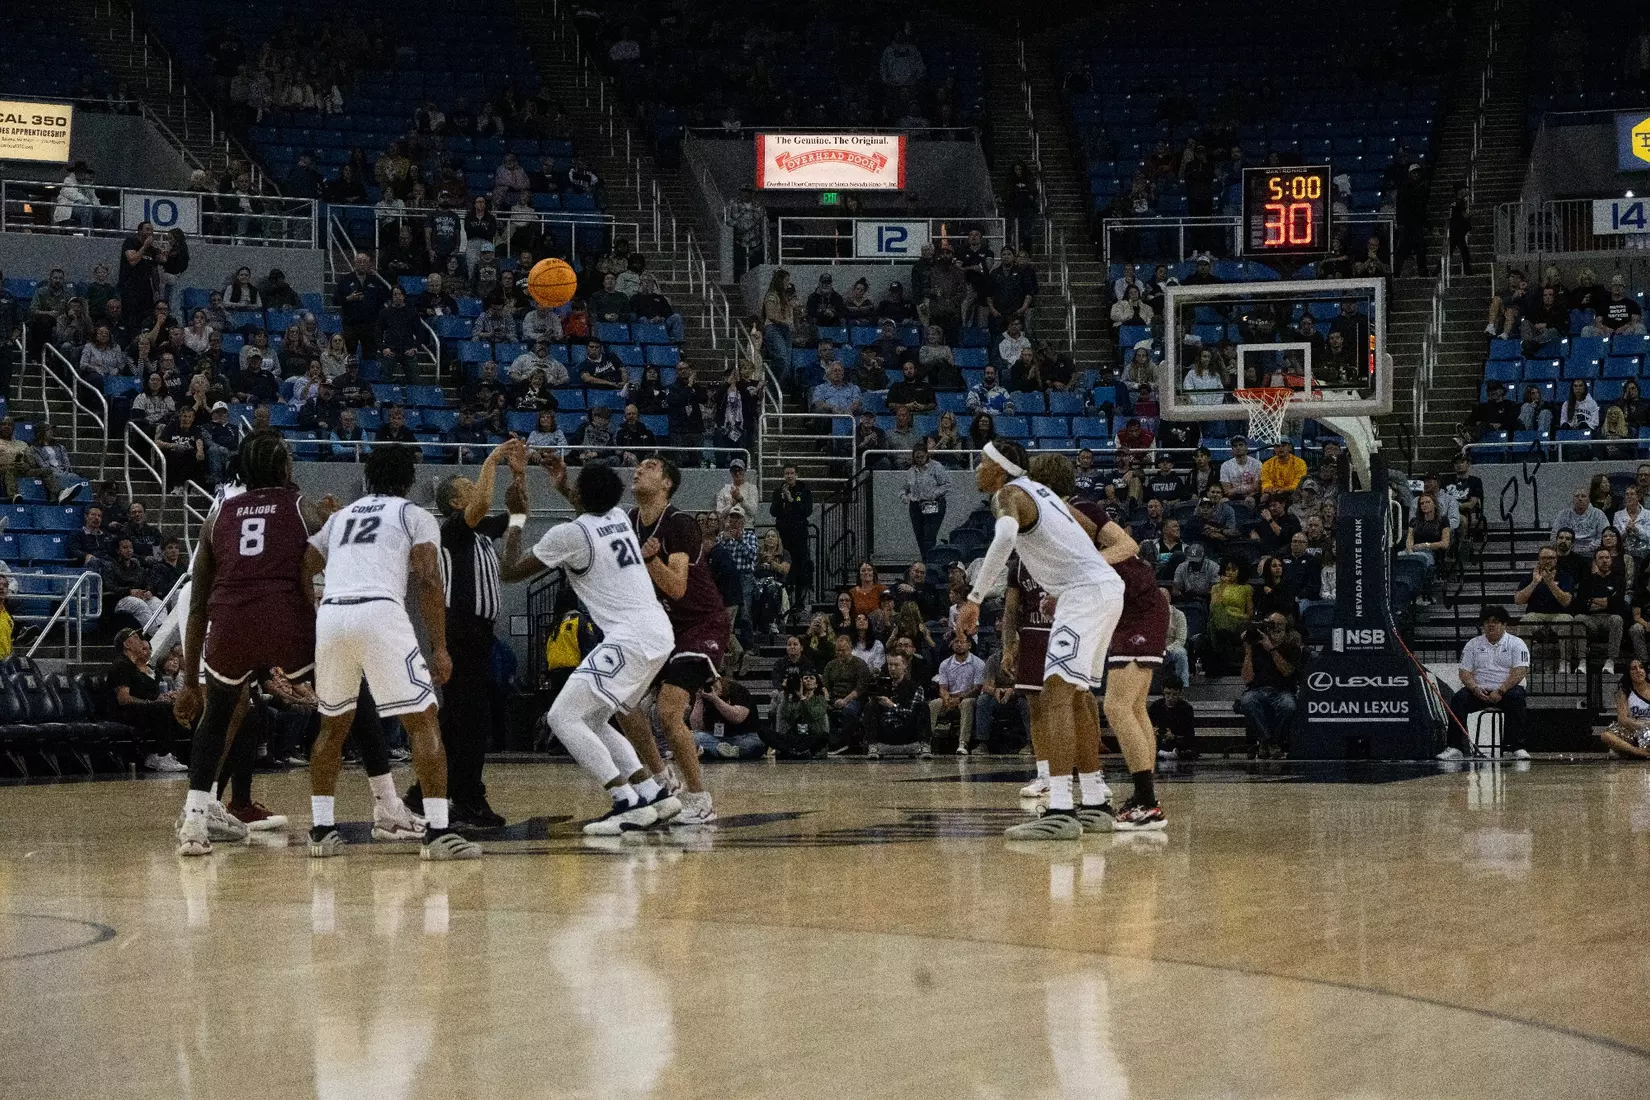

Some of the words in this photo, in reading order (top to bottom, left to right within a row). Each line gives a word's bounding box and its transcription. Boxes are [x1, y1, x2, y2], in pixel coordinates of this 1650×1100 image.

[0, 127, 10, 135] ES
[11, 128, 67, 138] APPRENTICESHIP
[32, 115, 67, 127] 350
[775, 136, 791, 145] The
[794, 136, 831, 145] Genuine.
[833, 136, 849, 145] The
[851, 136, 889, 146] Original.
[787, 151, 845, 169] OVERHEAD
[847, 153, 875, 169] DOOR
[1269, 176, 1321, 200] 5:00
[143, 198, 179, 227] 10
[1264, 203, 1312, 245] 30
[1612, 202, 1648, 230] 14
[877, 226, 908, 252] 12
[239, 517, 266, 557] 8
[339, 516, 382, 547] 12
[1355, 518, 1363, 545] BANK
[610, 537, 641, 568] 21
[1355, 547, 1363, 576] STATE
[1355, 578, 1363, 617] NEVADA
[1346, 629, 1385, 645] NSB
[1335, 676, 1409, 687] LEXUS
[1308, 701, 1360, 714] DOLAN
[1364, 701, 1409, 714] LEXUS
